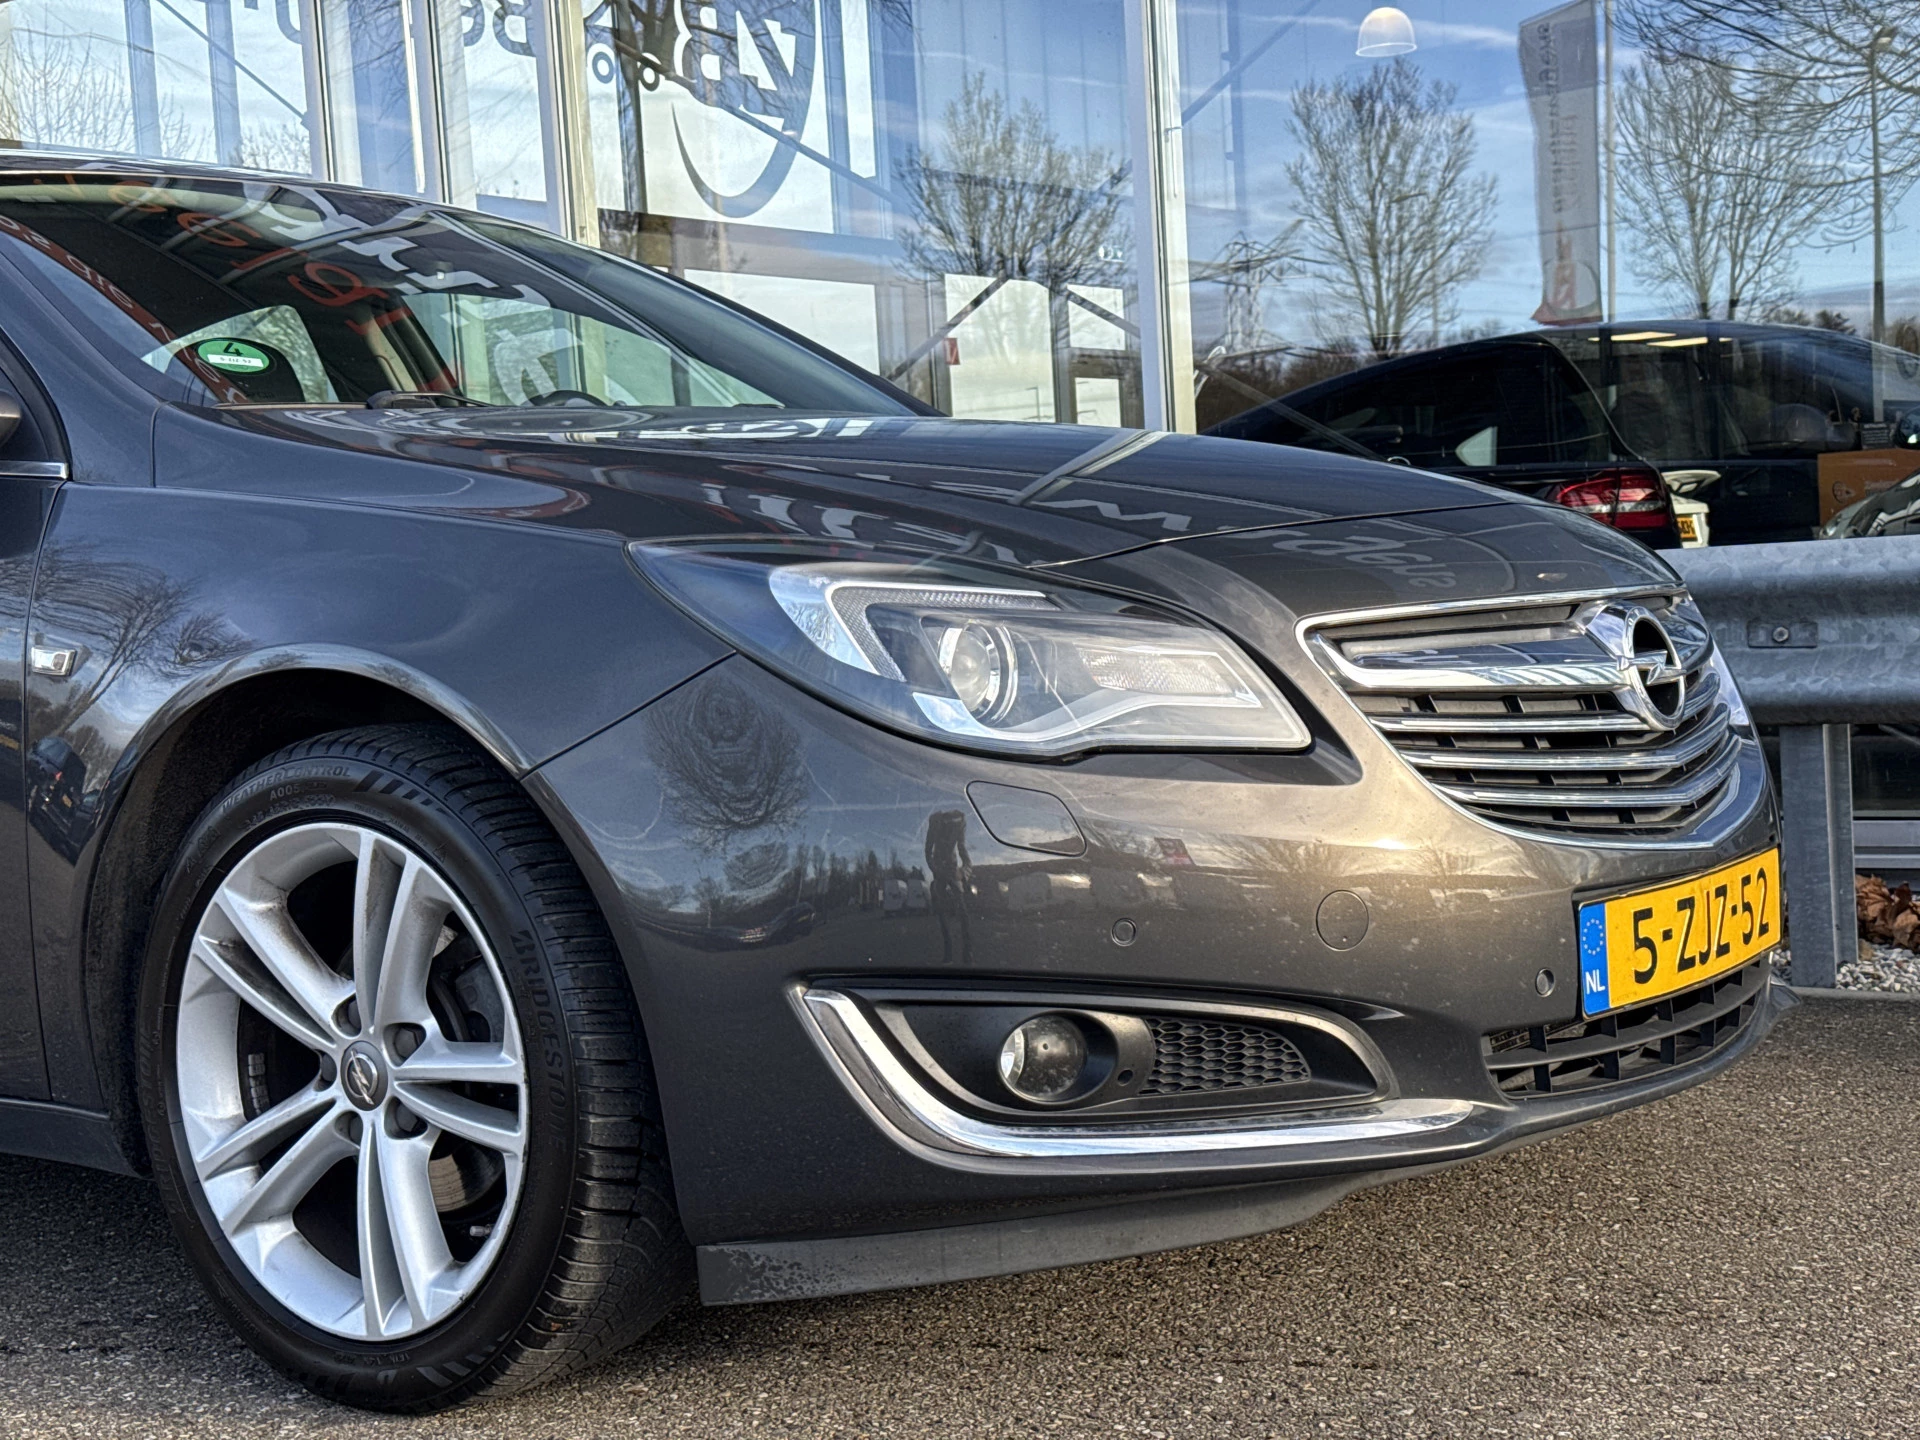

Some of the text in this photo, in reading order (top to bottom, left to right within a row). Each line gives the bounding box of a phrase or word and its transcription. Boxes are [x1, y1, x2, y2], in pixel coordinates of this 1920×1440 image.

[223, 342, 243, 356] 4
[1631, 867, 1770, 985] 5-ZJZ-52
[1585, 968, 1606, 995] NL
